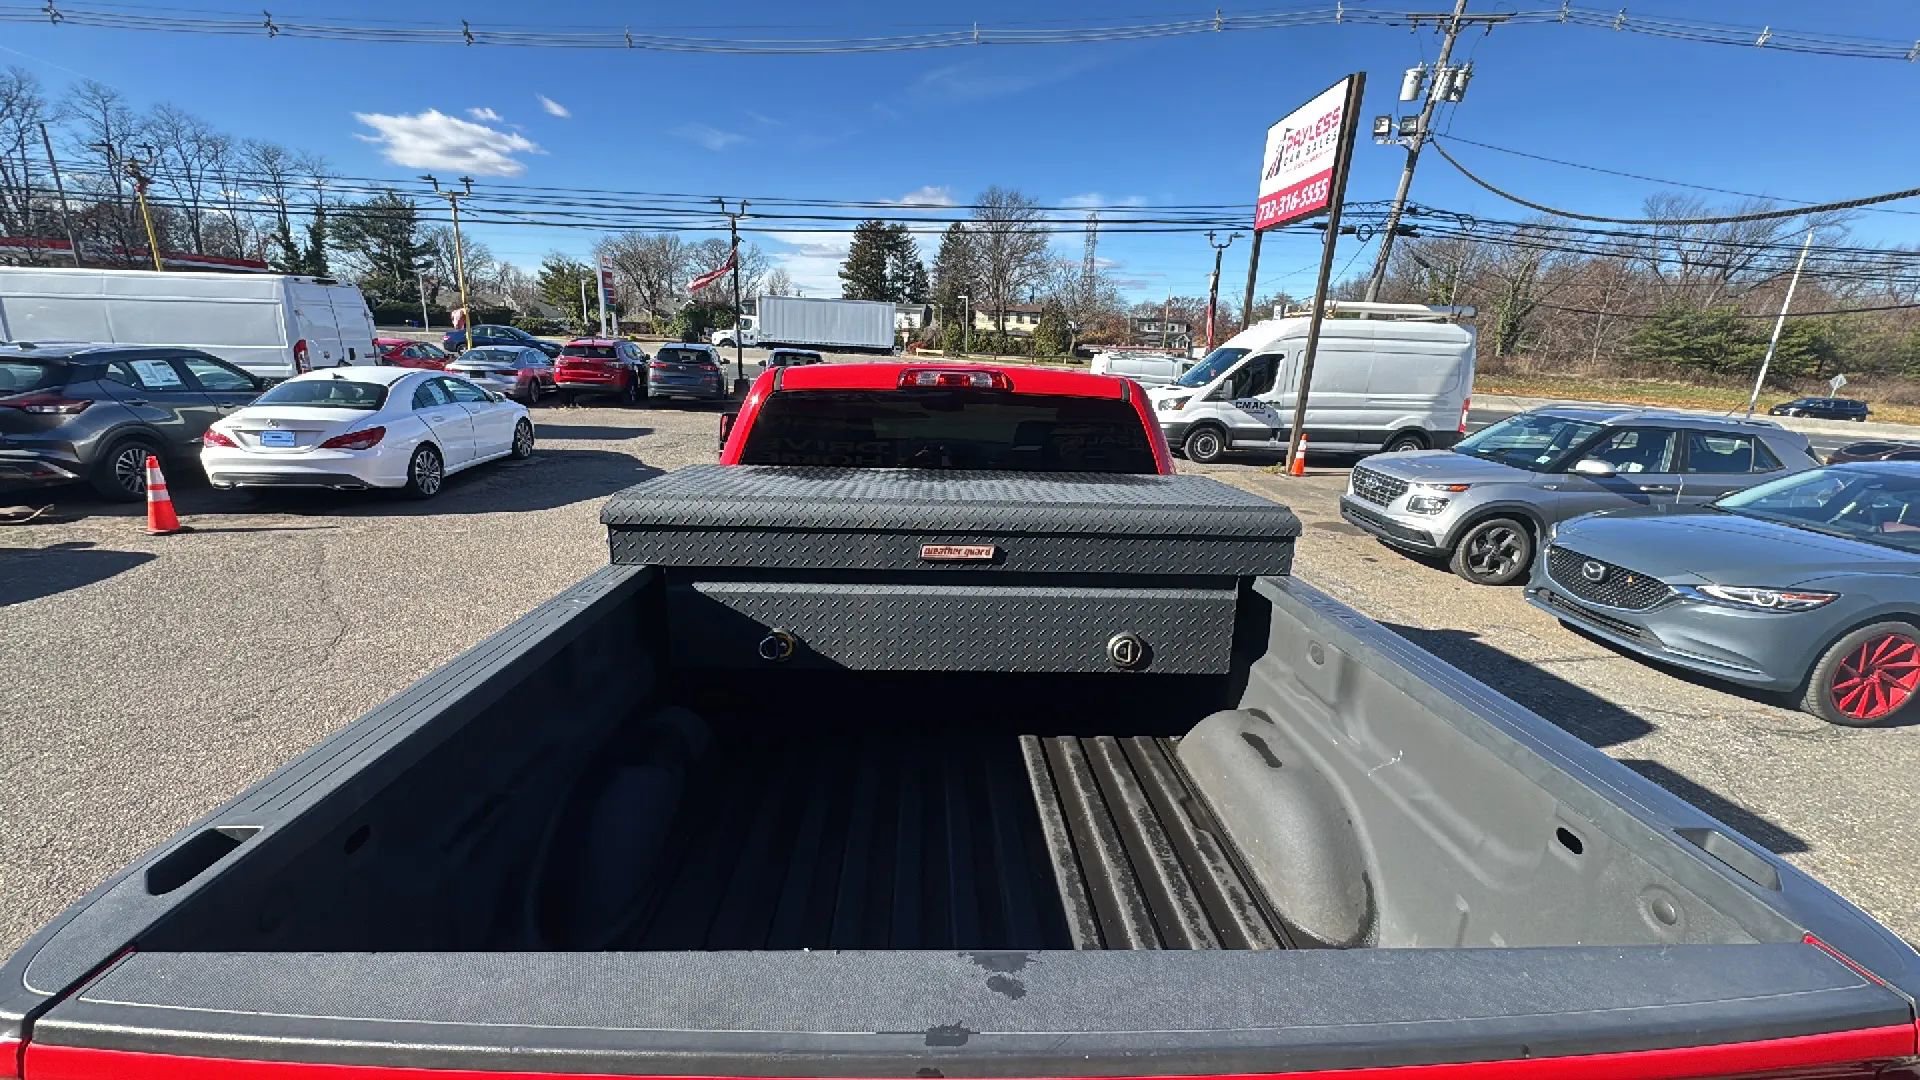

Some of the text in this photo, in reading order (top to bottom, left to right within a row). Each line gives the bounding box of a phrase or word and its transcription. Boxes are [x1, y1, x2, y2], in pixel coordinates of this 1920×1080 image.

[1284, 149, 1301, 167] CAR
[1306, 130, 1337, 156] SALES
[1286, 106, 1341, 153] PAYLESS
[1258, 178, 1329, 222] 732-316-5555
[964, 547, 991, 557] guard
